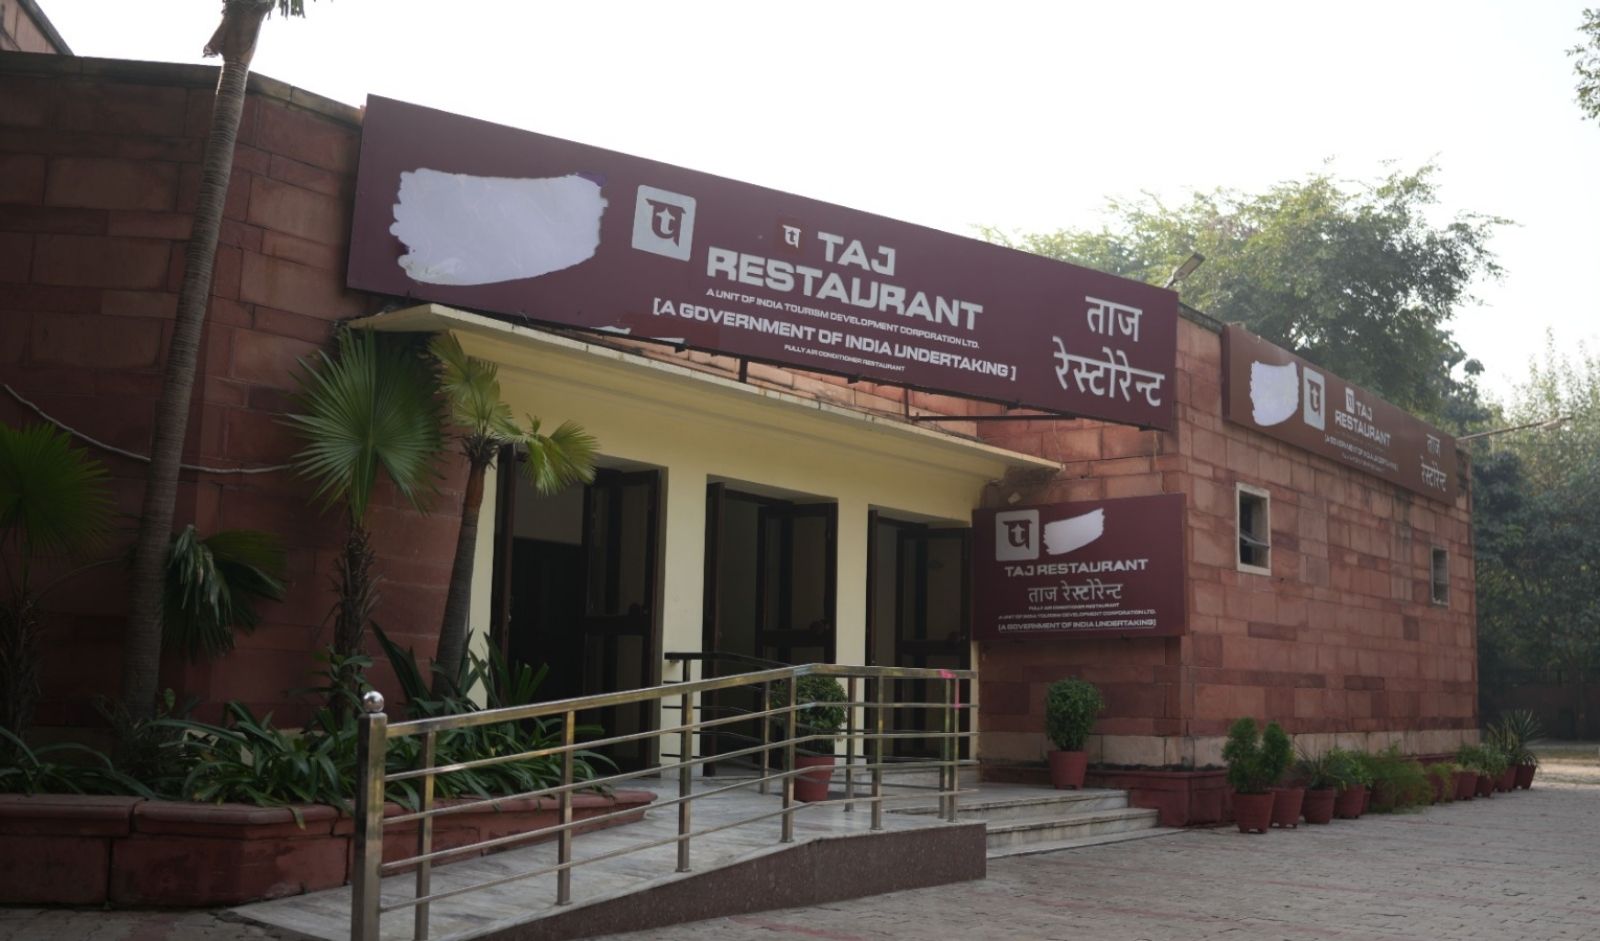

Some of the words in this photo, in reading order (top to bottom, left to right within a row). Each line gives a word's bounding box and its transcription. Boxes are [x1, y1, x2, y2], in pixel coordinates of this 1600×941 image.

[817, 231, 896, 277] TAJ
[706, 246, 983, 330] RESTAURANT
[679, 302, 816, 341] GOVERNMENT
[818, 329, 843, 346] OF
[845, 334, 892, 356] INDIA
[706, 287, 715, 297] A
[715, 289, 740, 302] UNIT
[741, 294, 756, 305] OF
[756, 297, 783, 310] INDIA
[784, 303, 829, 319] TOURISM
[830, 312, 899, 333] DEVELOPMENT
[899, 325, 961, 345] CORPORATION
[961, 338, 980, 349] LTD.
[1085, 295, 1143, 342] ताज
[784, 344, 806, 354] FULLY
[805, 348, 818, 357] AIR
[862, 359, 906, 372] RESTAURANT
[1052, 335, 1165, 407] रेस्टोरेन्ट
[1334, 409, 1391, 447] RESTAURANT
[1355, 401, 1372, 422] TAJ
[1004, 564, 1034, 577] TAJ
[1036, 558, 1149, 576] RESTAURANT
[1027, 586, 1058, 603] ताज
[1060, 578, 1123, 601] रेस्टोरेन्ट
[1007, 622, 1061, 630] GOVERNMENT
[1073, 620, 1094, 628] INDIA
